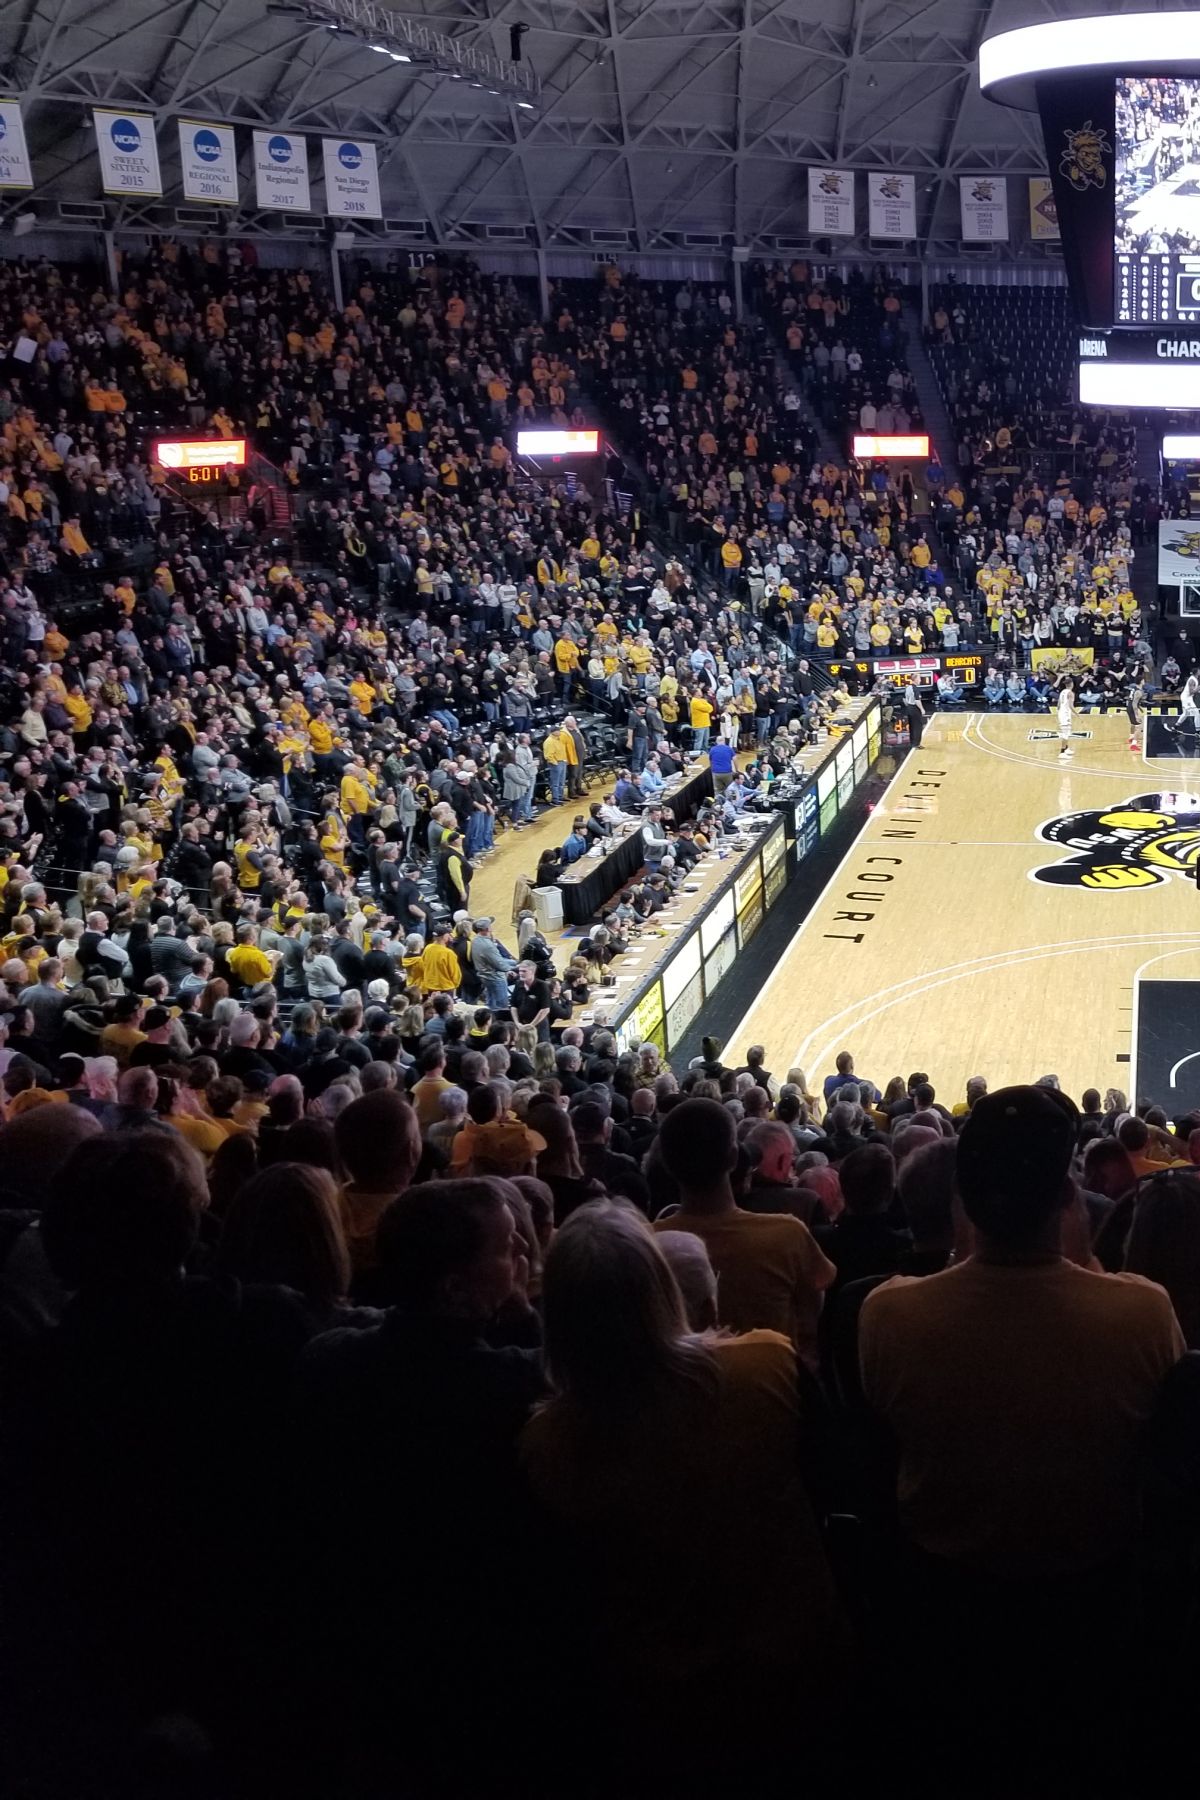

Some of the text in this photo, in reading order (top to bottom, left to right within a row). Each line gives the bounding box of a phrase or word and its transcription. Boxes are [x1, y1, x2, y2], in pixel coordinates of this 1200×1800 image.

[114, 134, 140, 145] NCAA
[197, 144, 221, 154] NCAA
[113, 156, 144, 164] SWEET
[110, 163, 149, 173] SIXTEEN
[258, 162, 305, 174] Indianapolis
[121, 174, 144, 186] 2015
[189, 171, 232, 182] REGIONAL
[266, 175, 299, 185] Regional
[350, 177, 370, 186] Diego
[200, 182, 221, 194] 2016
[338, 185, 368, 194] Regional
[272, 194, 295, 204] 2017
[344, 201, 365, 212] 2018
[190, 467, 219, 481] 6:01
[946, 656, 982, 667] BEARCATS
[966, 669, 974, 682] 0
[1066, 828, 1147, 849] WSU
[823, 856, 903, 944] COURT
